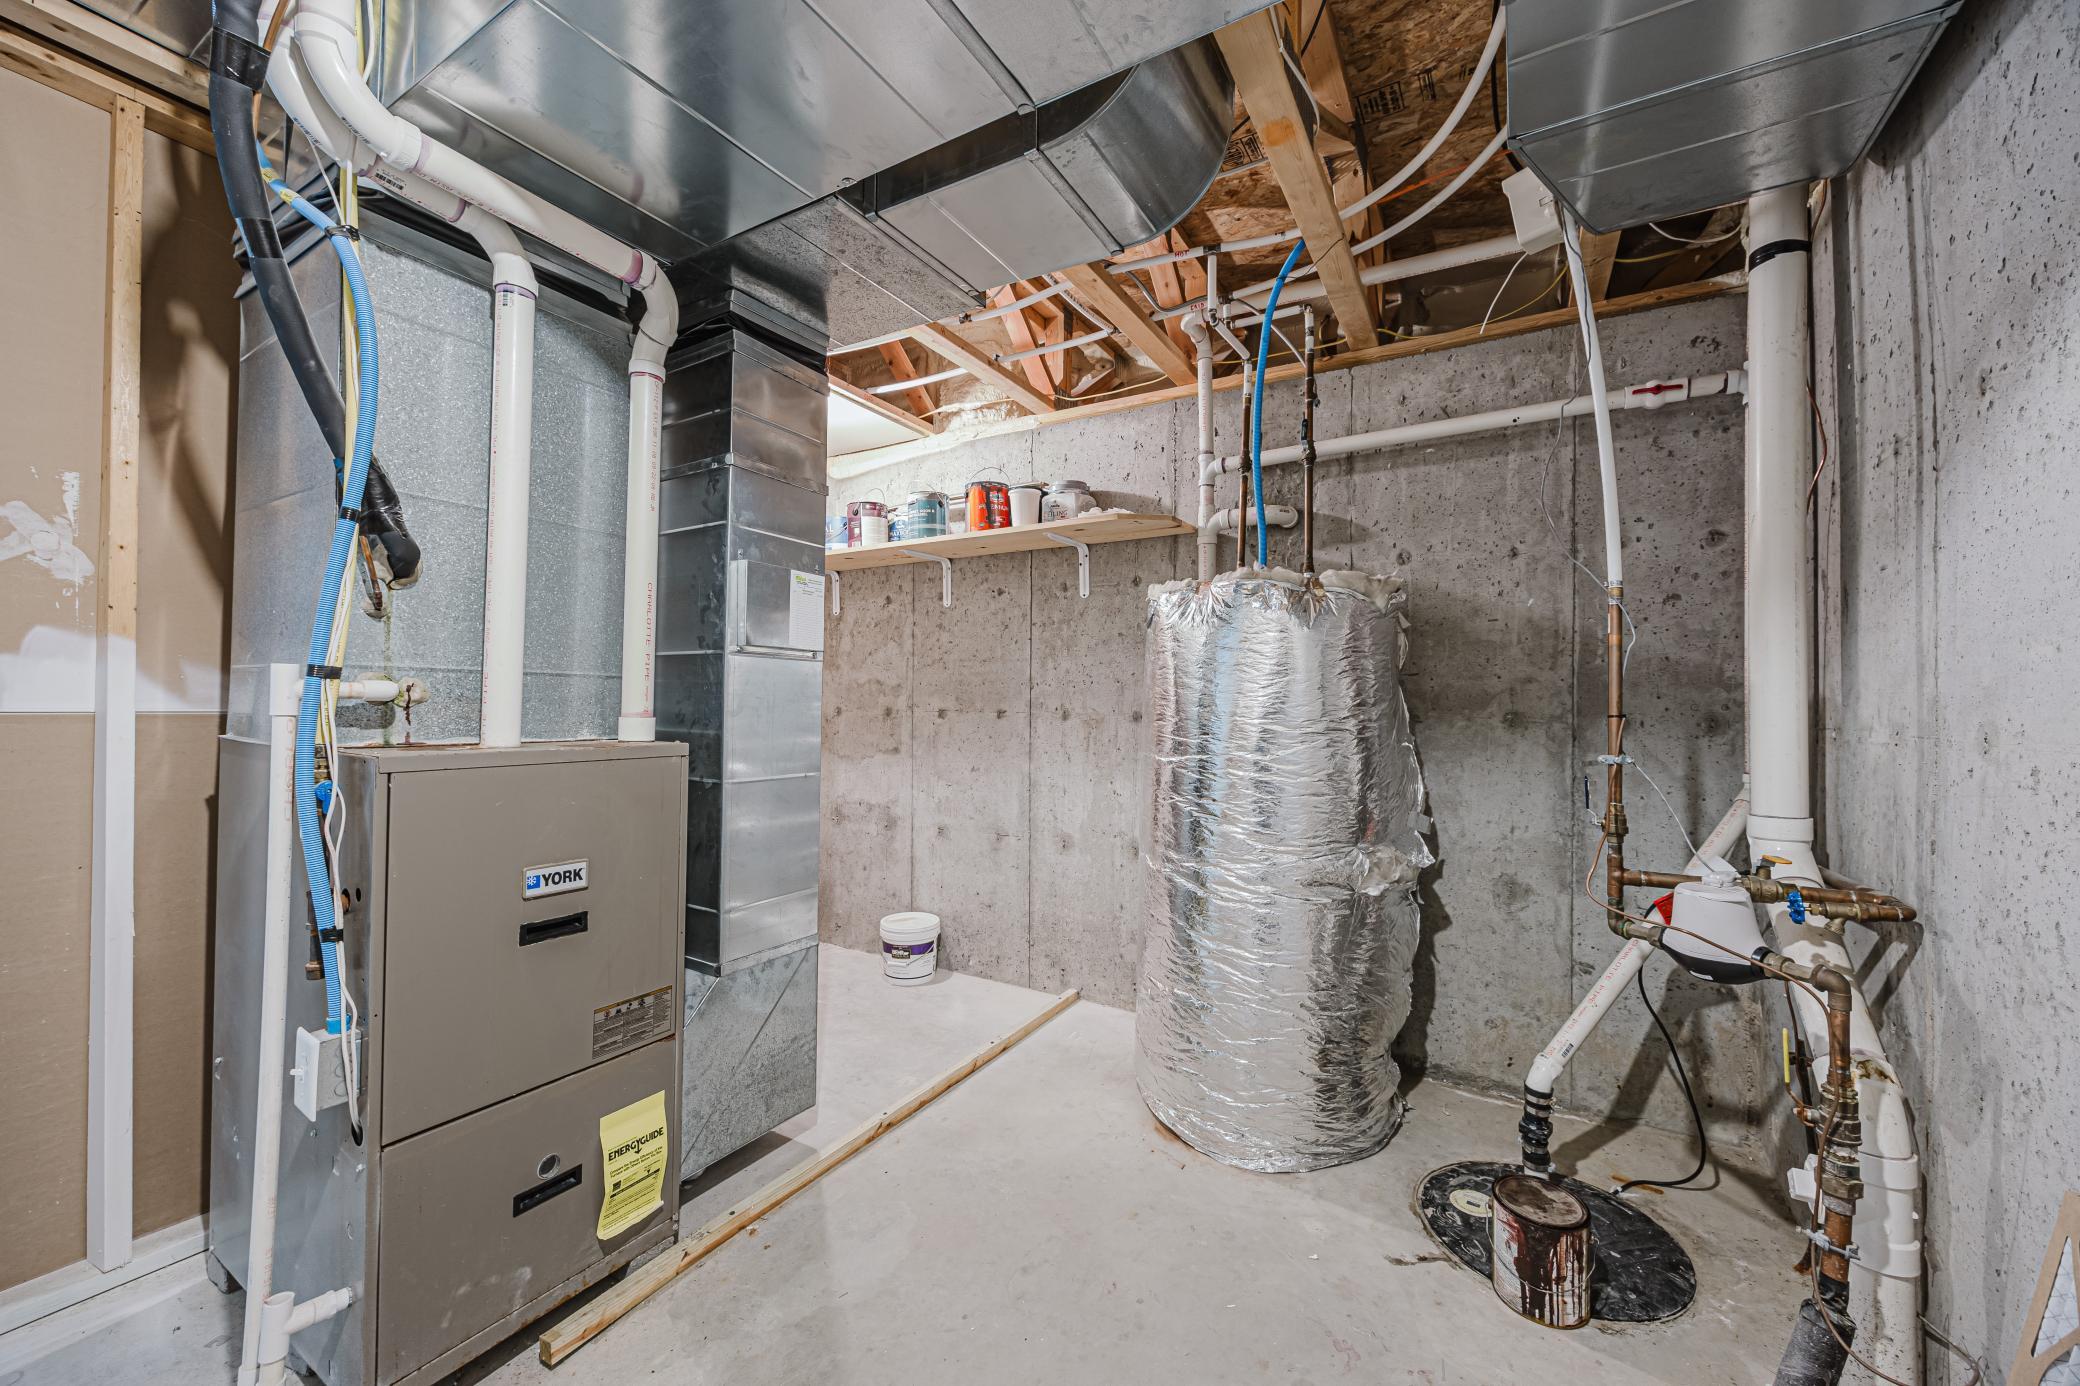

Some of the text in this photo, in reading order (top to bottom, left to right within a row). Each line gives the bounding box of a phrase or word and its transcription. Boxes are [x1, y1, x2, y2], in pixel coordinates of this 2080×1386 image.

[1174, 249, 1190, 258] HOT
[645, 582, 653, 646] CHARLOTTE
[542, 868, 583, 886] YORK
[1587, 984, 1605, 1004] PIPE
[608, 1127, 664, 1162] ENERGYGUIDE
